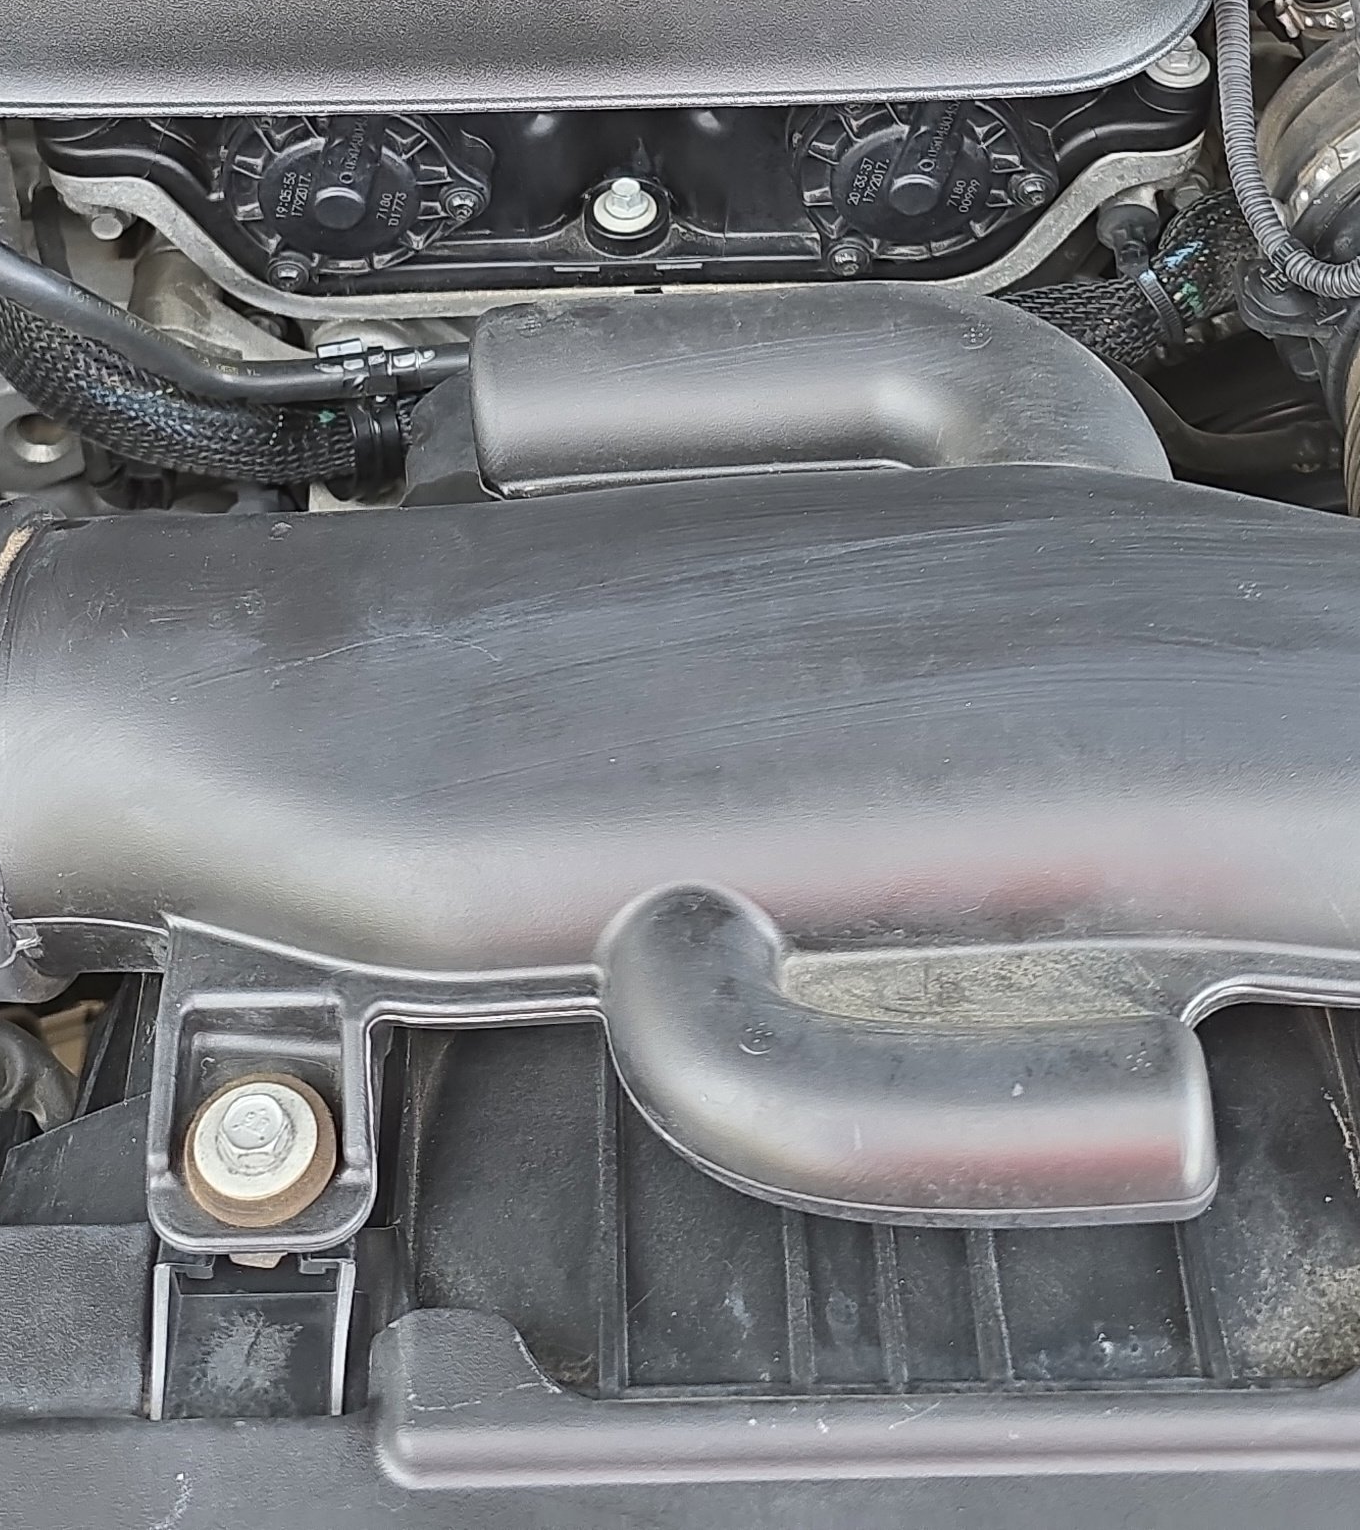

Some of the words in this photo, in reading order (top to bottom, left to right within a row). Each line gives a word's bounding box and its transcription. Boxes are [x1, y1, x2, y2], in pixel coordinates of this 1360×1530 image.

[276, 172, 298, 218] 19:05:56
[946, 179, 967, 207] 7180
[959, 179, 982, 214] 00999
